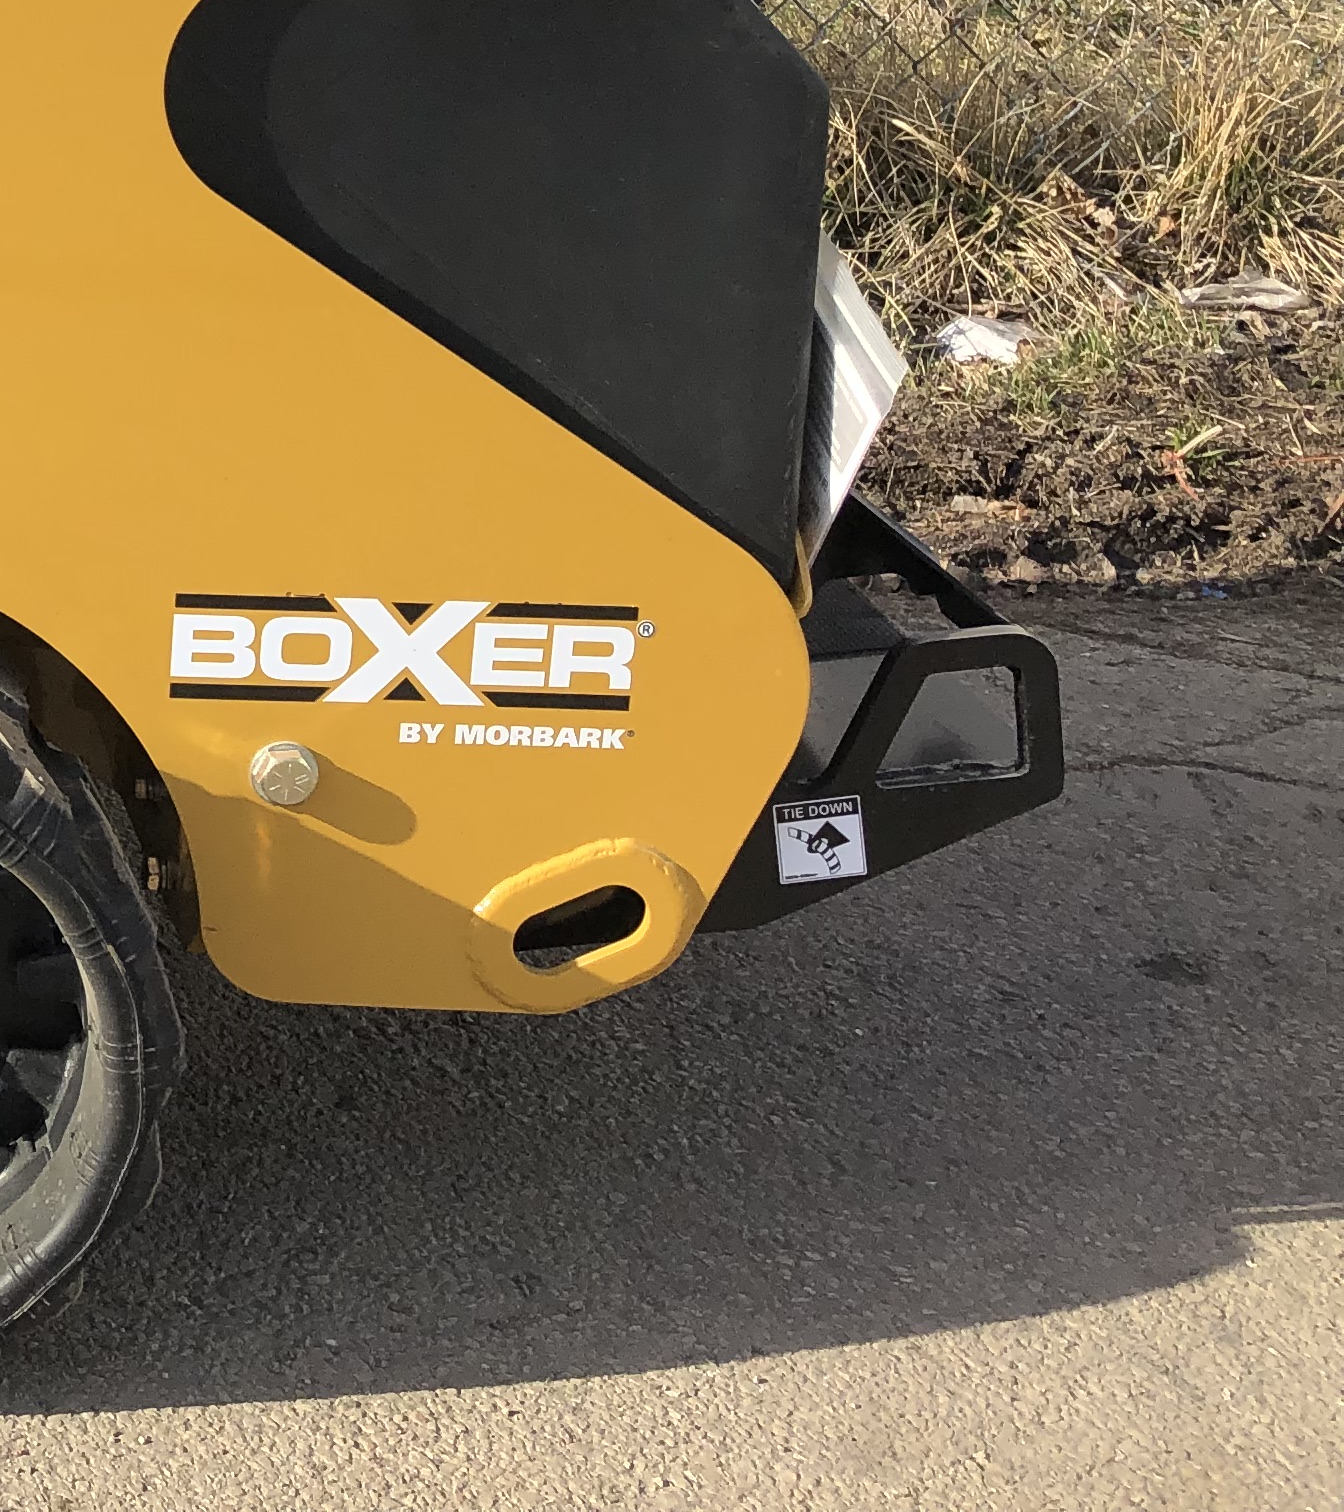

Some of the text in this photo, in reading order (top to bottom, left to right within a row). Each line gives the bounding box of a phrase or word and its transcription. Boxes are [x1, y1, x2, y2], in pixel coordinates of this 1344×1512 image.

[169, 597, 636, 707] BOXER
[398, 722, 625, 750] BY MORBARK
[783, 801, 852, 819] TIE DOWN
